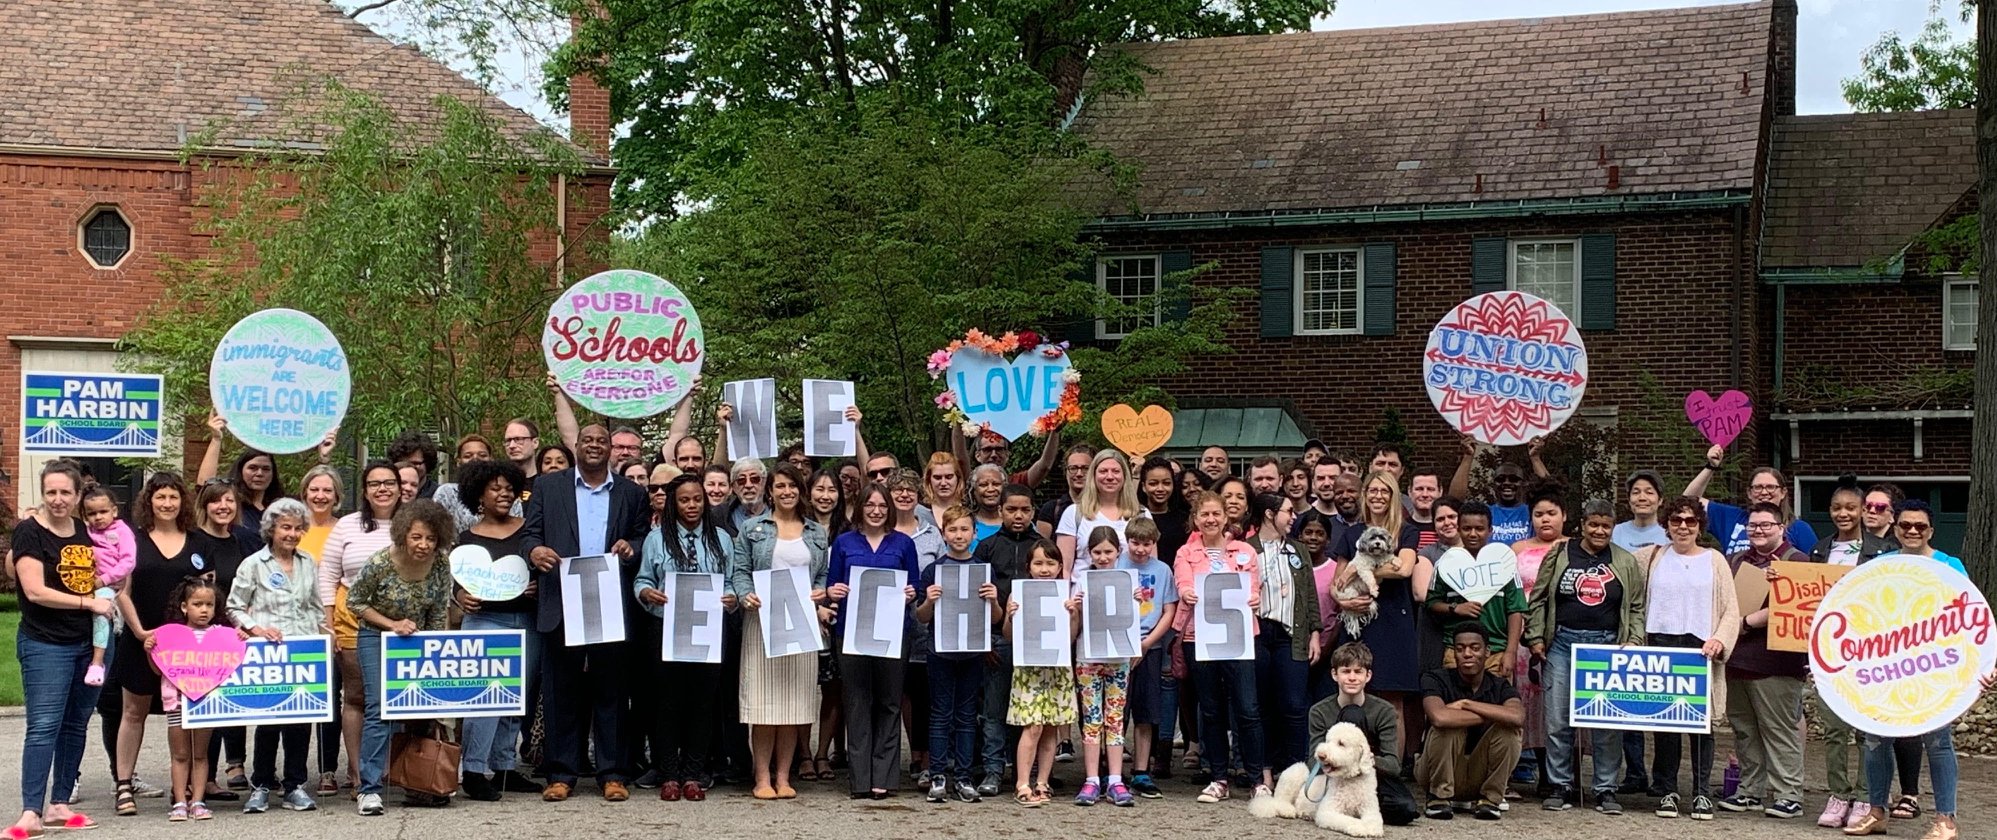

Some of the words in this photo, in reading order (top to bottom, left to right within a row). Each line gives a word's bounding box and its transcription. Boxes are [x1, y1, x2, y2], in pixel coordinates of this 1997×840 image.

[571, 291, 683, 318] PUBLIC
[551, 316, 700, 364] Schools
[1438, 328, 1581, 374] UNION
[223, 339, 345, 371] immigrants
[271, 370, 297, 382] ARE
[583, 368, 617, 380] ARE
[620, 368, 655, 380] FOR
[1428, 363, 1572, 407] STRONG
[63, 379, 124, 399] PAM
[566, 375, 678, 399] EVERYONE
[957, 365, 1065, 414] LOVE
[36, 399, 149, 419] HARBIN
[220, 385, 338, 415] WELCOME
[1693, 400, 1705, 413] I
[1706, 396, 1746, 419] trust
[259, 419, 304, 436] HERE
[1115, 415, 1159, 429] REAL
[1700, 413, 1743, 438] PAM
[1447, 562, 1503, 590] VOTE
[1811, 591, 1990, 673] Community
[157, 650, 240, 668] TEACHERS
[242, 644, 288, 664] AM
[424, 638, 484, 658] PAM
[397, 658, 511, 679] HARBIN
[1611, 653, 1670, 674] PAM
[1856, 648, 1960, 685] SCHOOLS
[220, 664, 316, 686] ARBIN
[420, 680, 456, 688] SCHOOL
[1585, 672, 1696, 695] HARBIN
[222, 687, 260, 695] SCHOOL
[262, 686, 293, 694] BOARD
[1606, 692, 1642, 700] SCHOOL
[1644, 694, 1674, 702] BOARD
